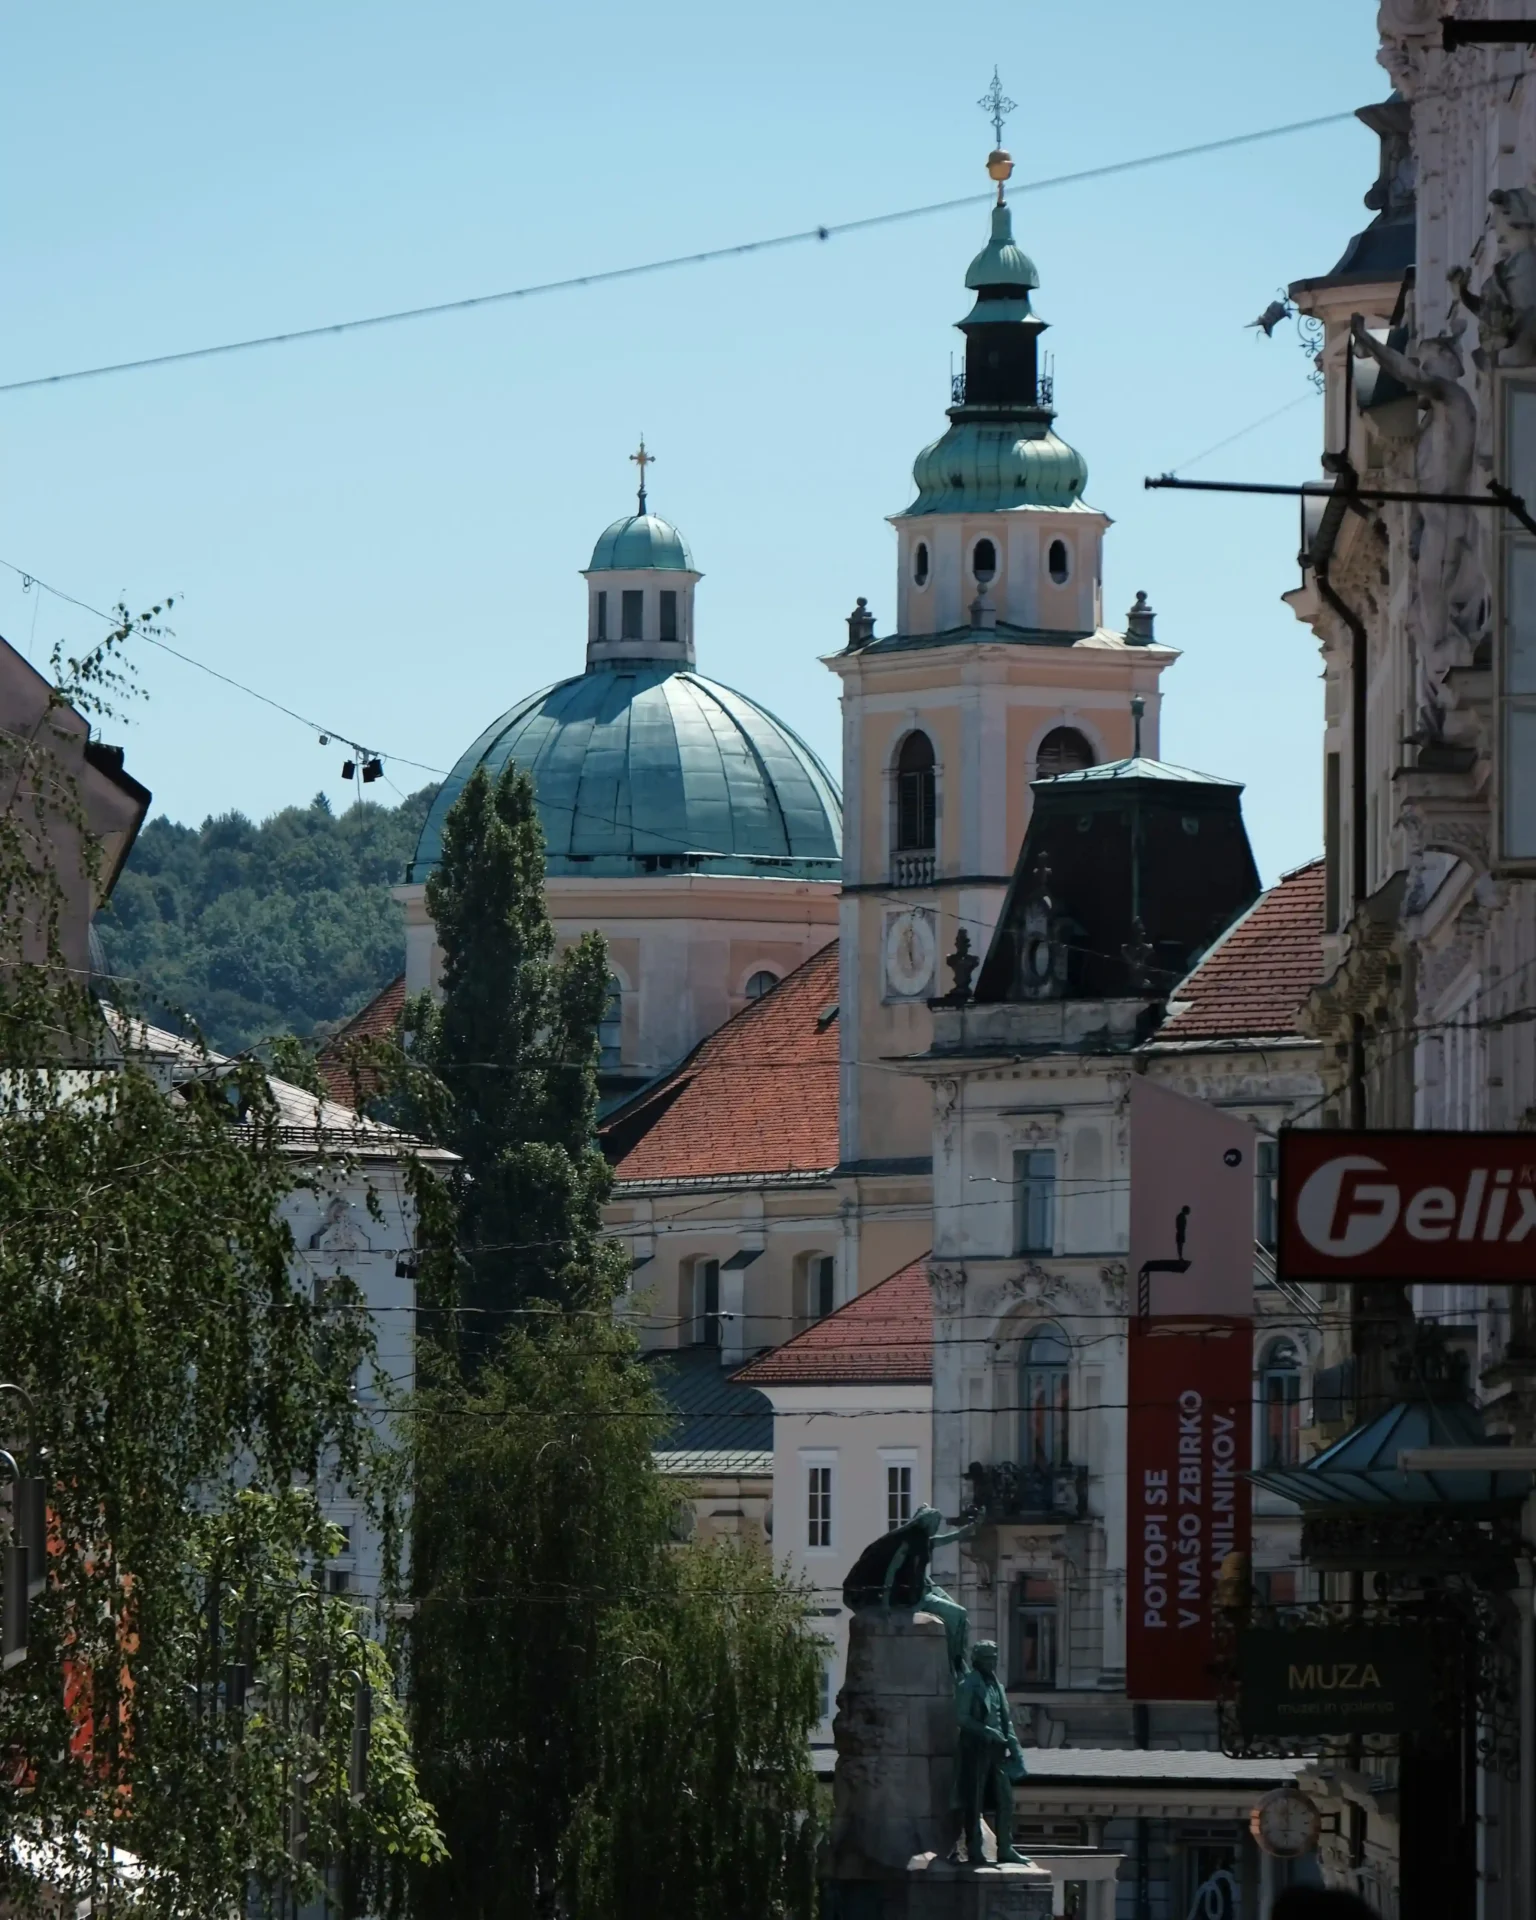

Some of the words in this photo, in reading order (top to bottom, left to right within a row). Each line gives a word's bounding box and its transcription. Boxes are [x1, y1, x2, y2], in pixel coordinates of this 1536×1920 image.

[1177, 1389, 1203, 1506] ZBIRKO
[1143, 1469, 1168, 1505] SE
[1143, 1514, 1168, 1628] POTOPI
[1172, 1513, 1201, 1600] NAŠO
[1177, 1607, 1201, 1629] V
[1288, 1663, 1382, 1690] MUZA
